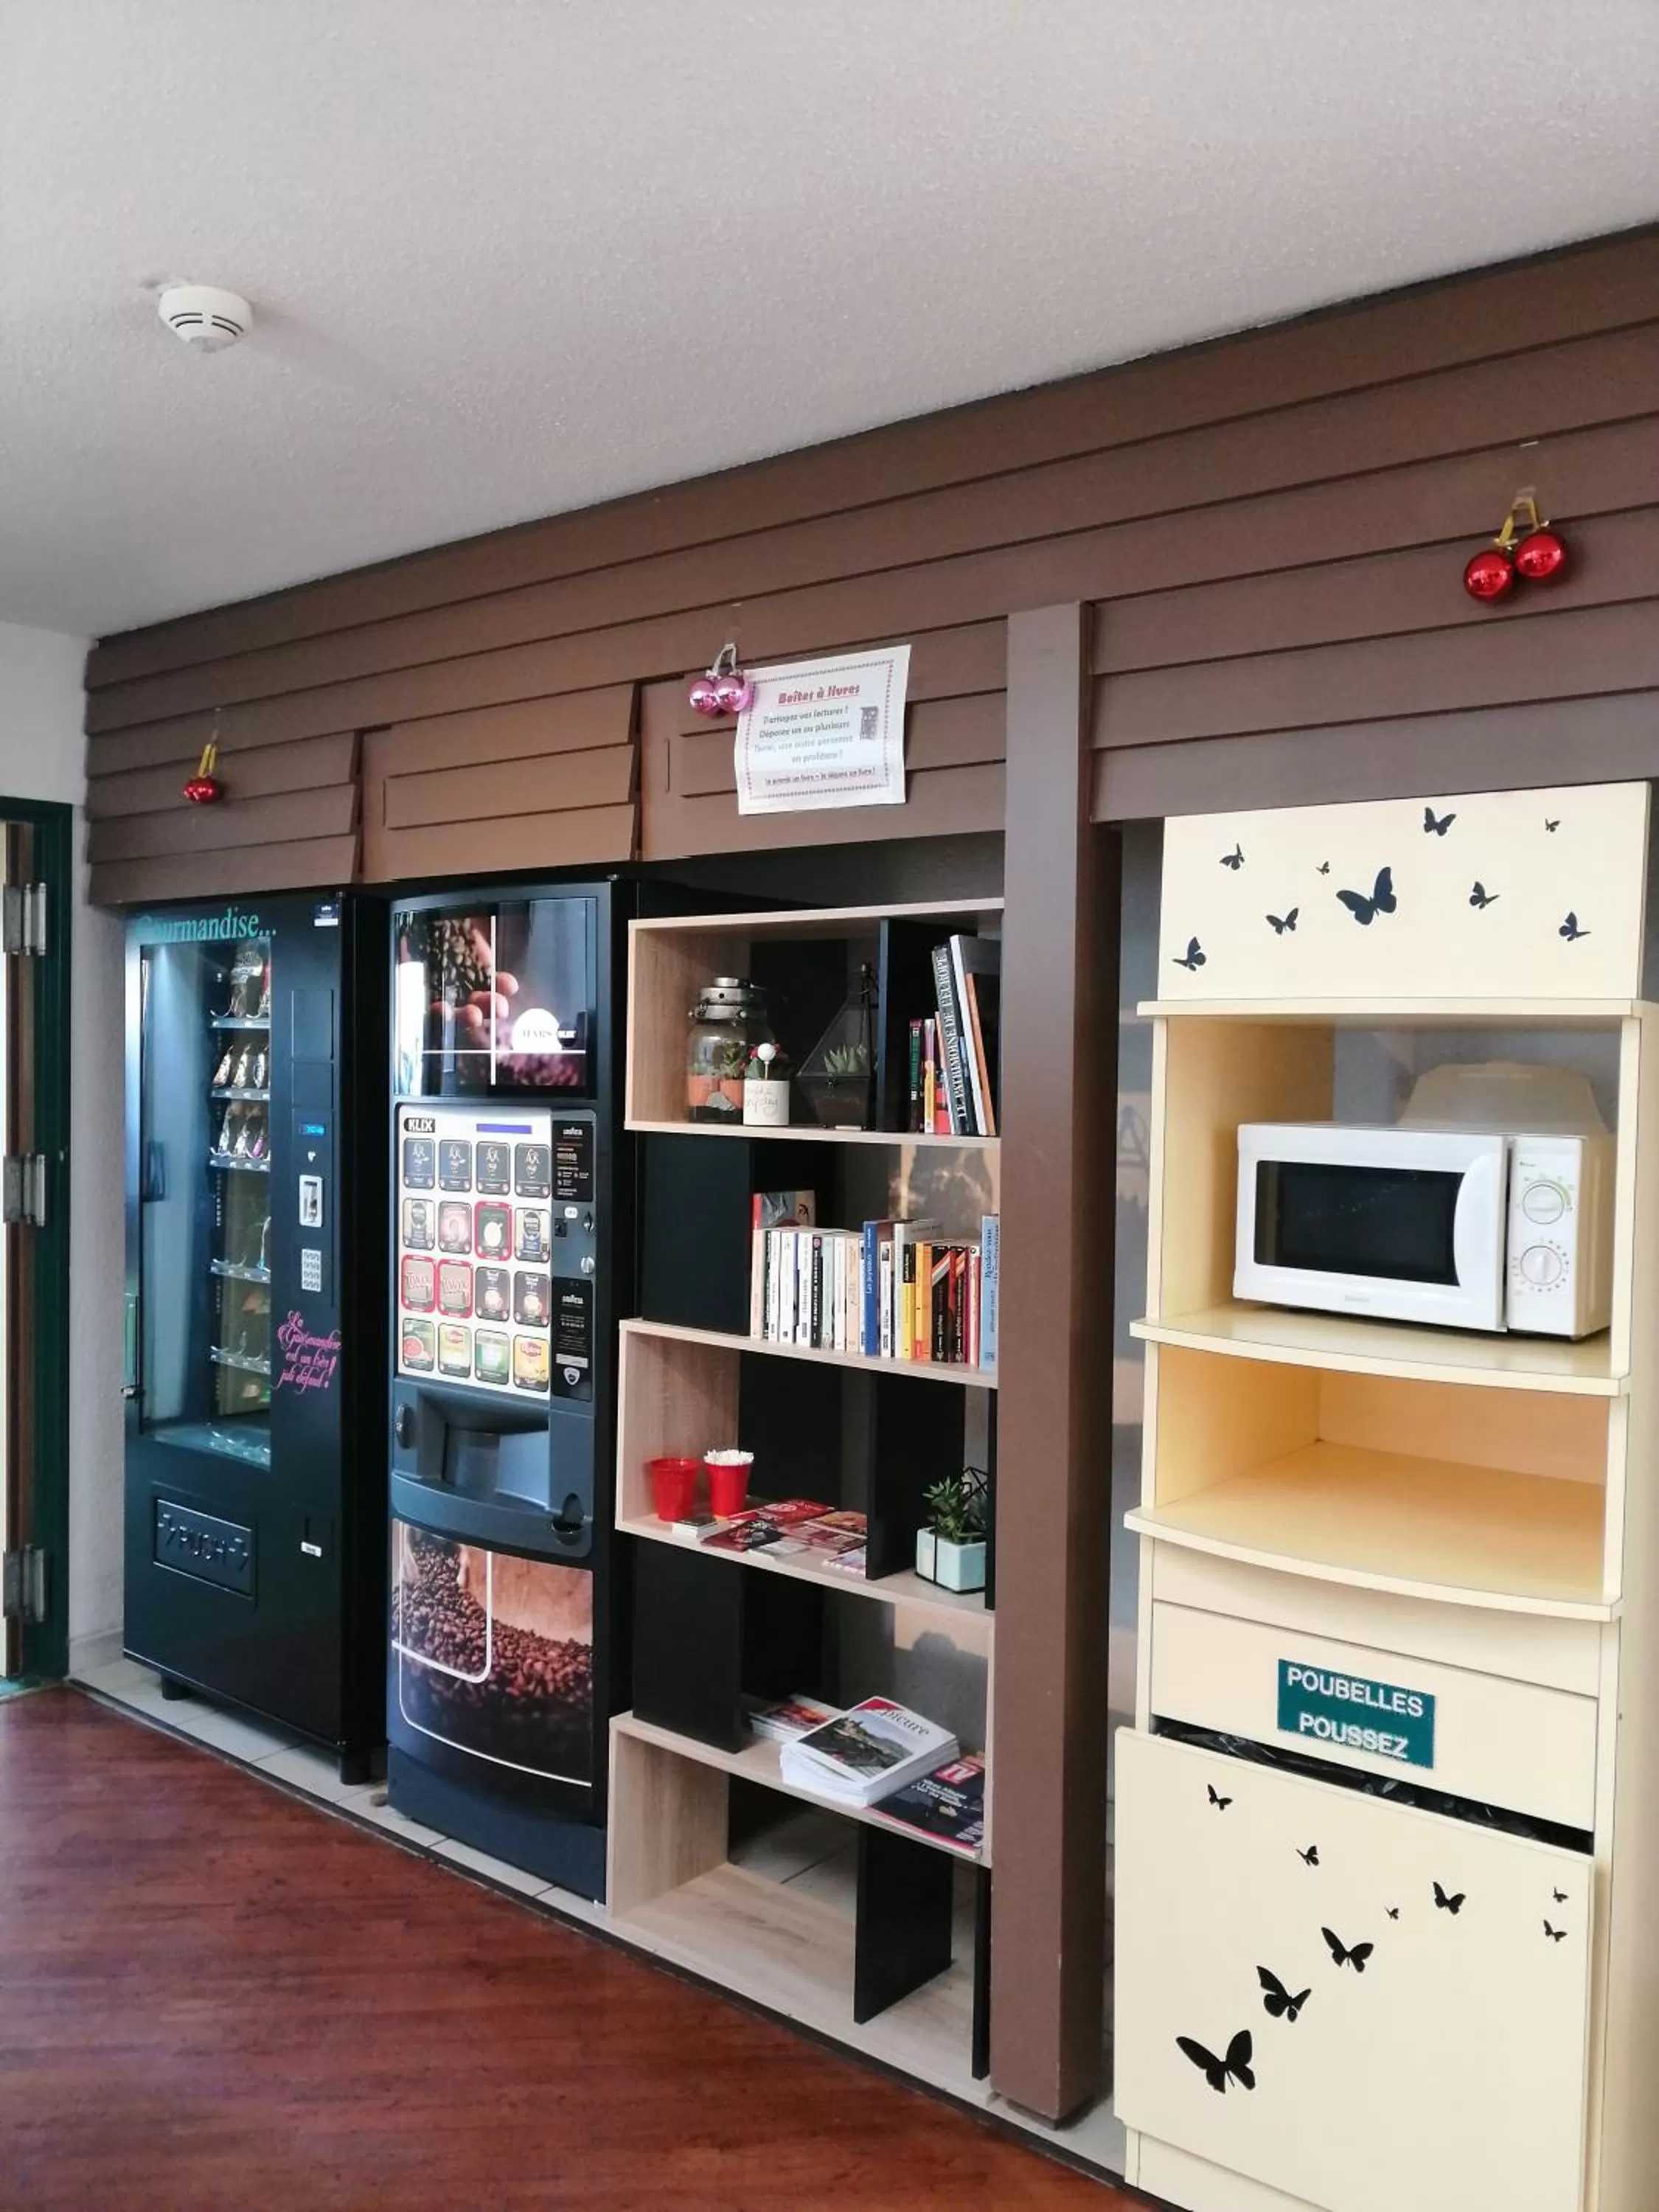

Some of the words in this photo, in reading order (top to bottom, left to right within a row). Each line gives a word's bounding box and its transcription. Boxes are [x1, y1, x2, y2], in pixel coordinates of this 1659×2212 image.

[817, 686, 824, 699] à
[827, 684, 860, 698] livres
[135, 906, 277, 942] urmandise...
[946, 1029, 964, 1098] PATRIMOINE
[408, 1119, 433, 1132] KLIX
[1287, 1666, 1424, 1718] POUBELLES
[1299, 1712, 1410, 1759] POUSSEZ
